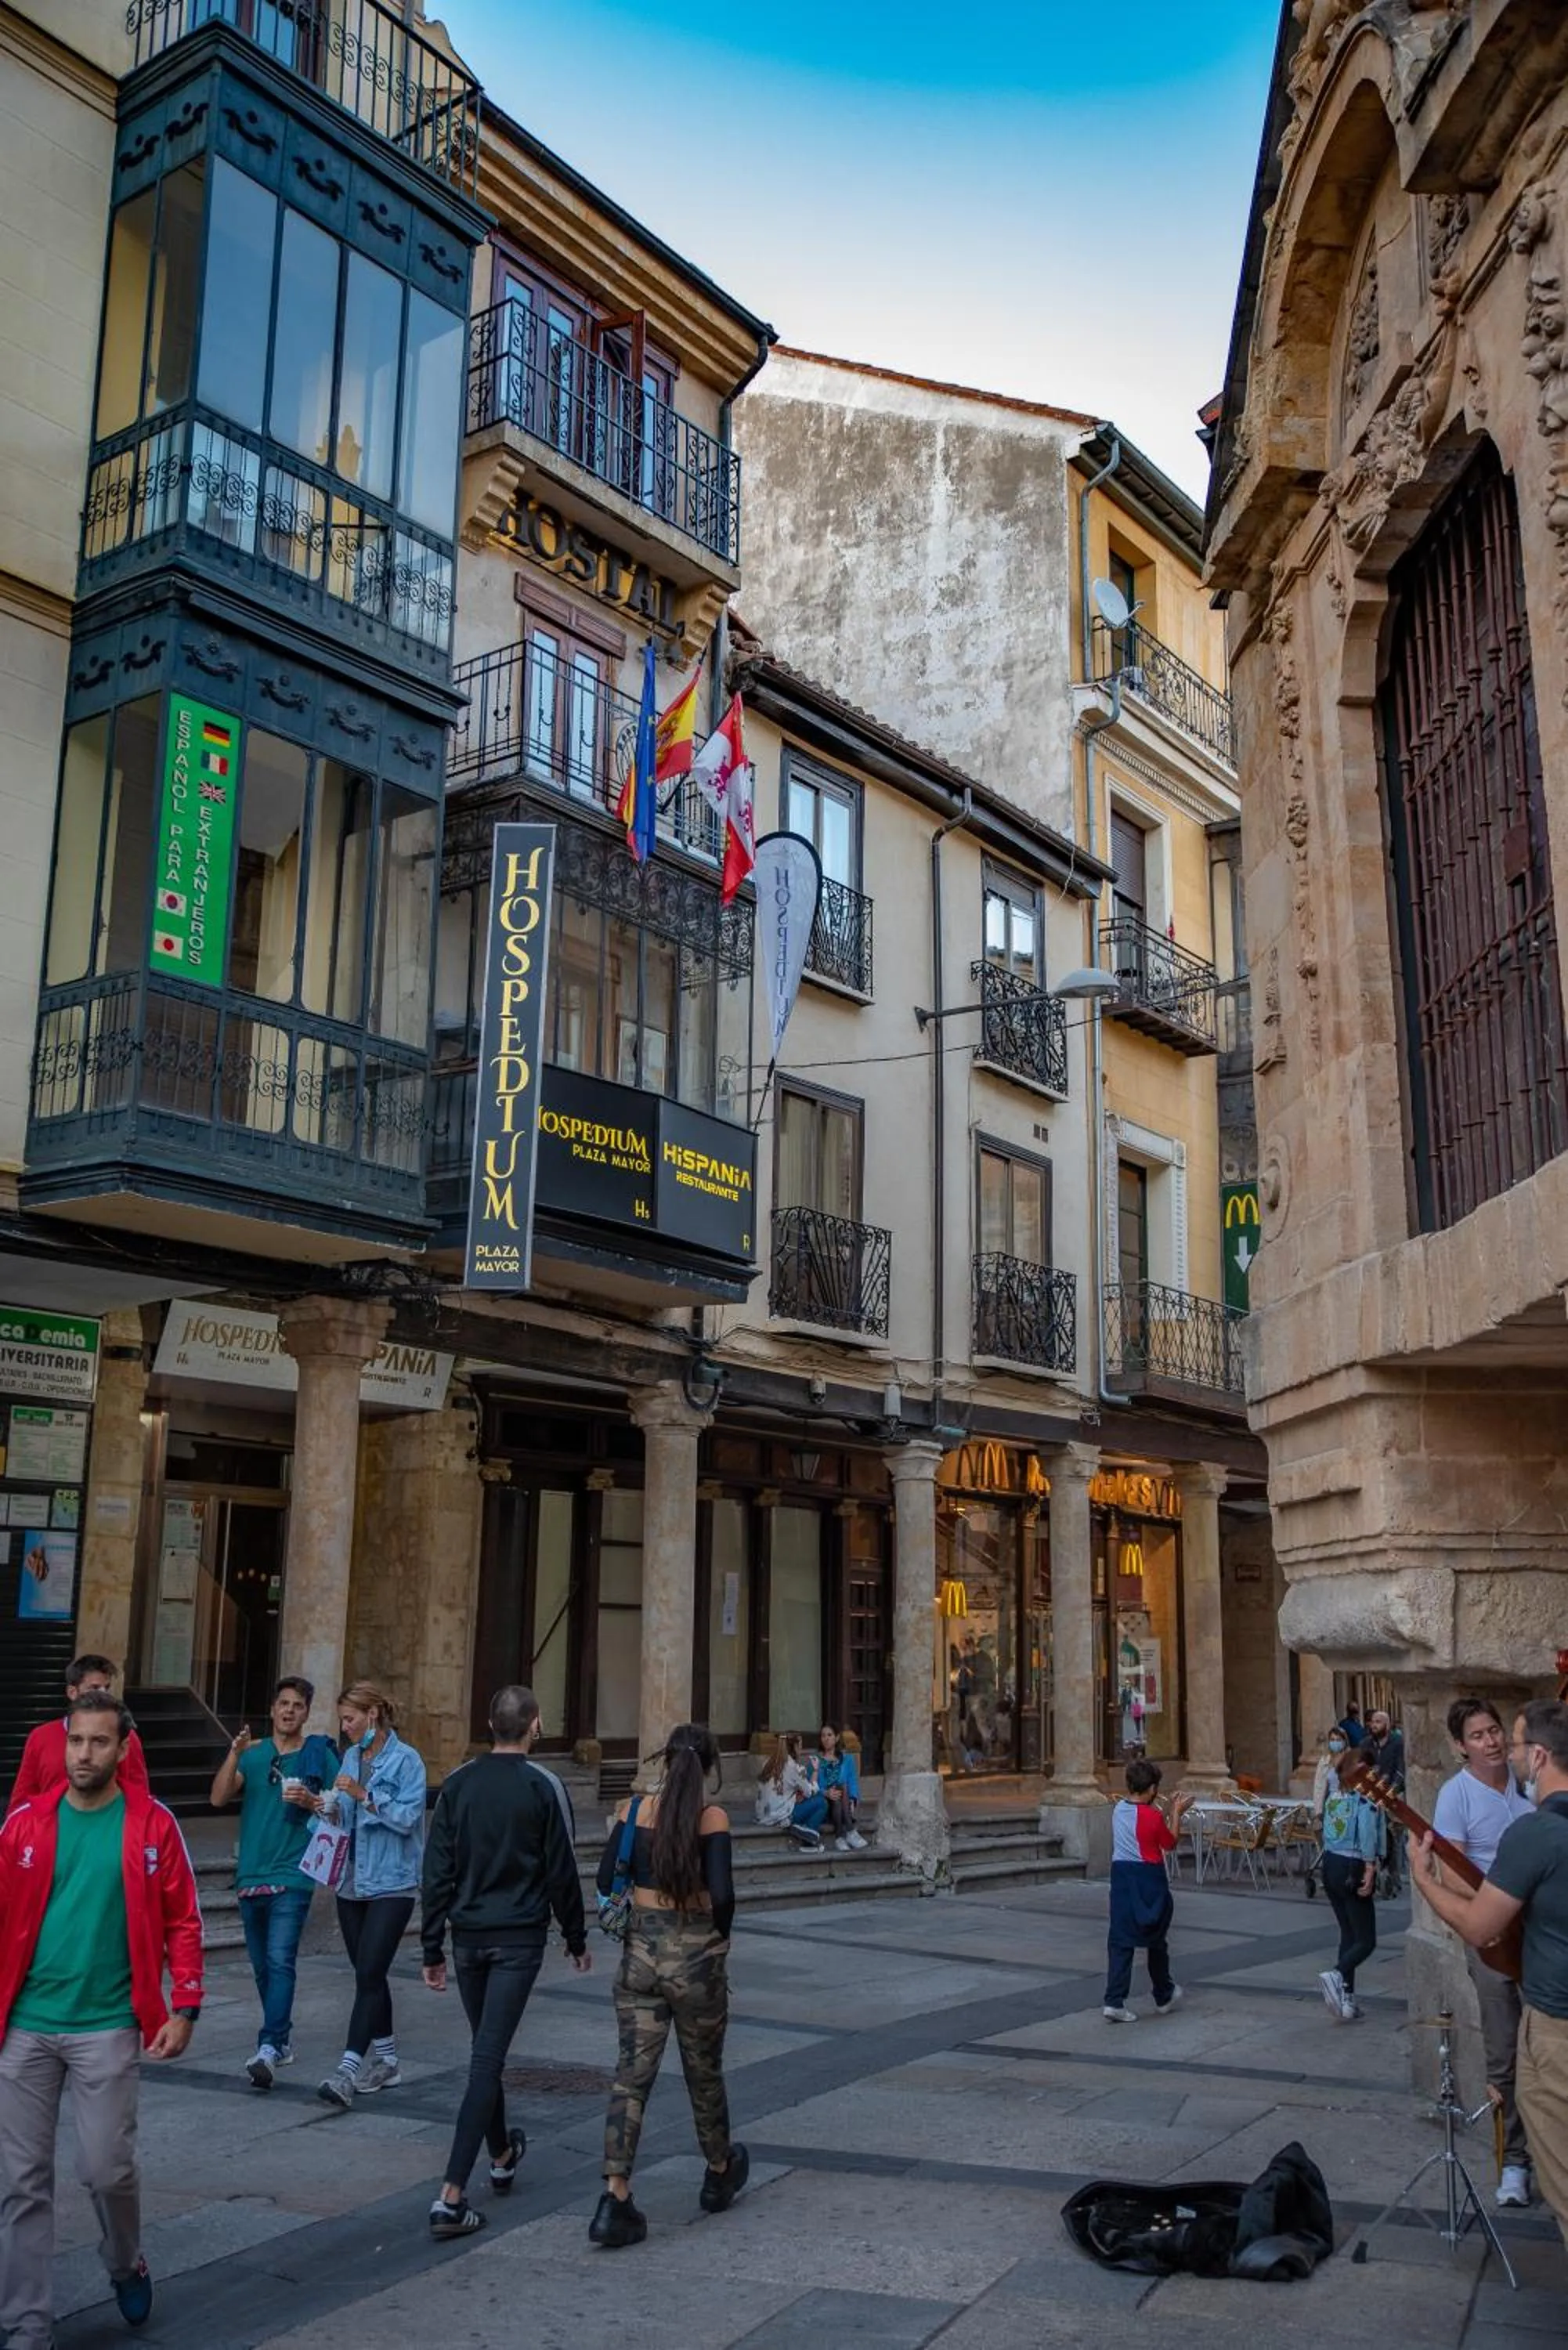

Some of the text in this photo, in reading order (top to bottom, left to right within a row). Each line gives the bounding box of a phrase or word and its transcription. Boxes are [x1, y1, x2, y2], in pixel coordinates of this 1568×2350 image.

[166, 823, 184, 884] PARA
[188, 806, 212, 966] EXTRANJEROS
[482, 846, 545, 1231] HOSPEDIUM
[572, 1144, 652, 1173] PLAZA MAYOR
[676, 1171, 739, 1202] RESTAURANTE
[475, 1245, 518, 1257] PLAZA
[475, 1260, 519, 1273] MAYOR
[180, 1315, 283, 1354] HOSPEDI
